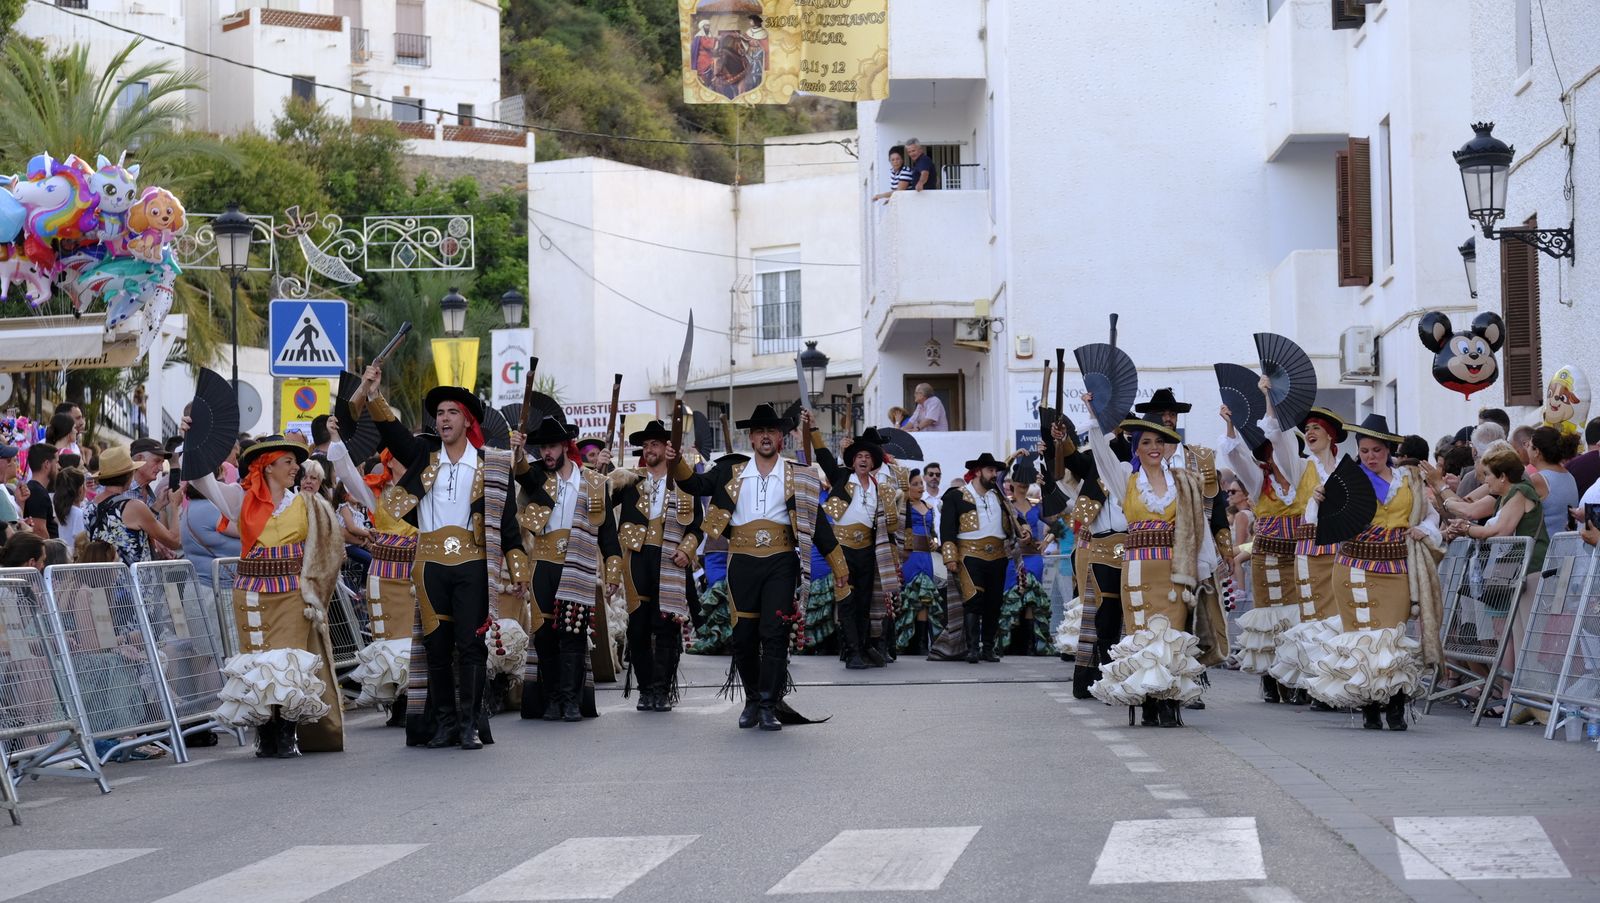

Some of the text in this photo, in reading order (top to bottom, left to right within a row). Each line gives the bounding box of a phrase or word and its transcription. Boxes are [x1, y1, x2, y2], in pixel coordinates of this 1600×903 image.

[802, 11, 814, 24] Y
[820, 63, 829, 77] y
[832, 61, 847, 73] 12
[829, 79, 858, 92] 2022
[561, 403, 637, 416] OMESTILES
